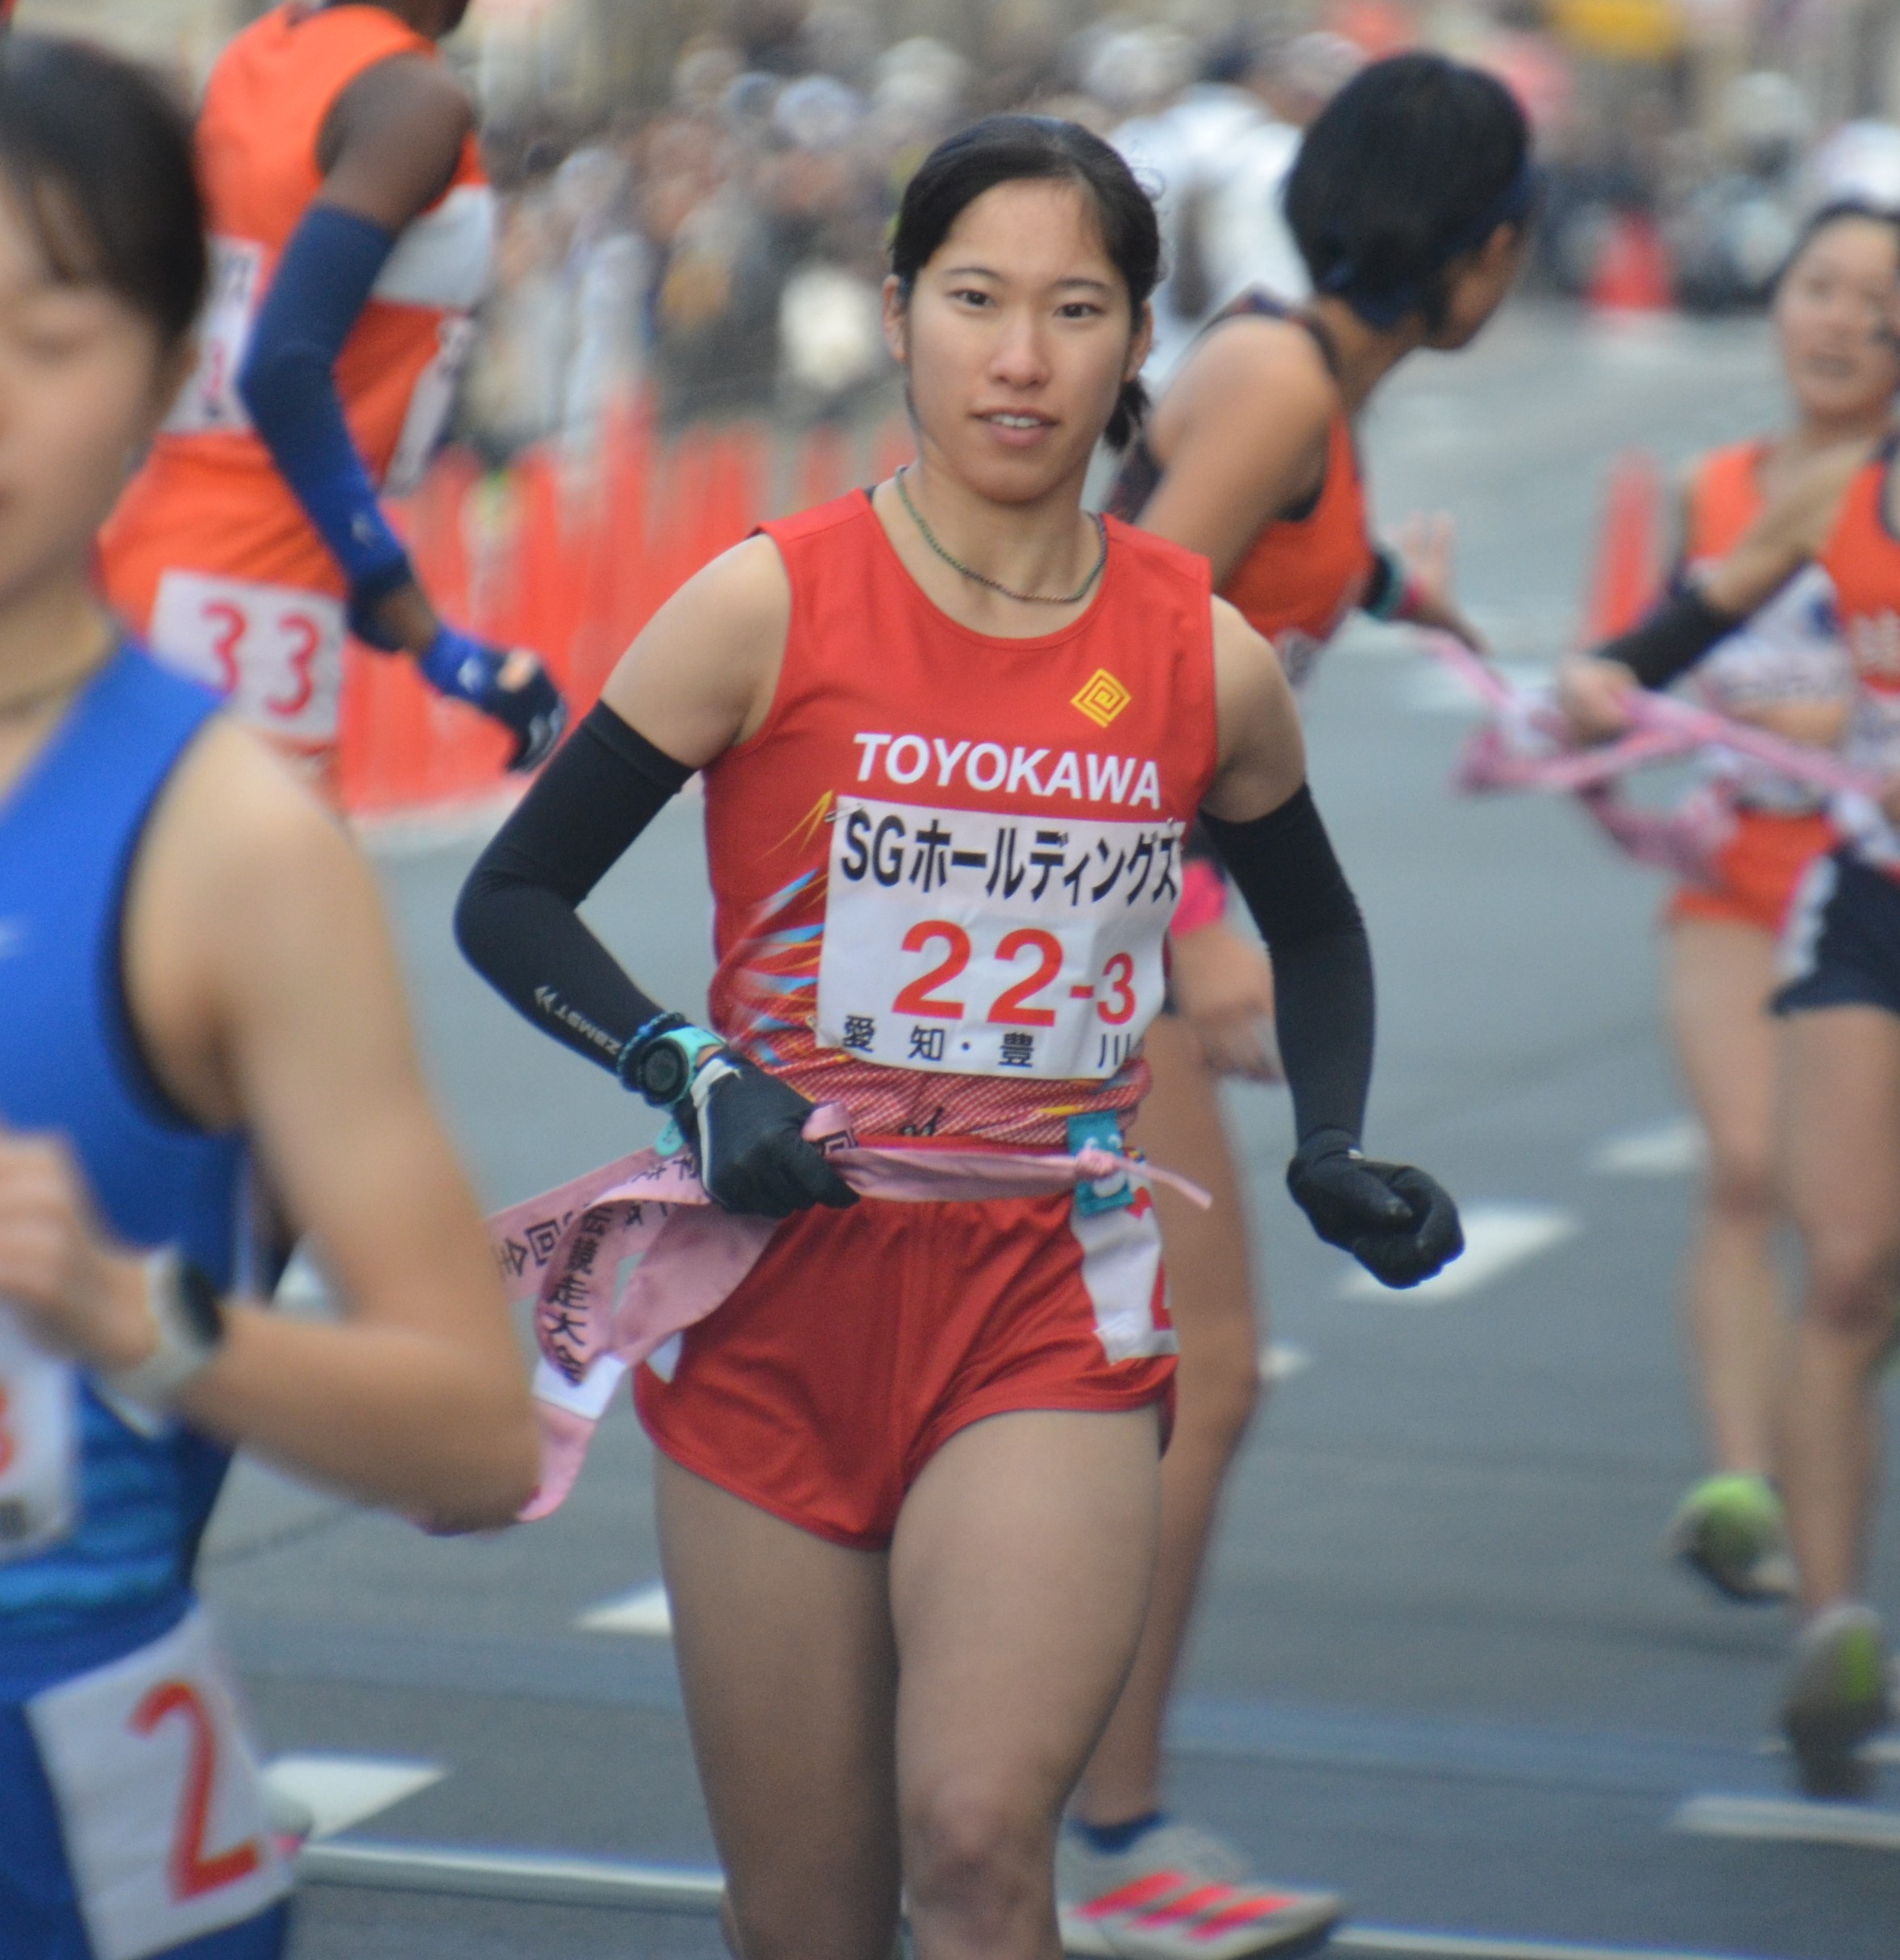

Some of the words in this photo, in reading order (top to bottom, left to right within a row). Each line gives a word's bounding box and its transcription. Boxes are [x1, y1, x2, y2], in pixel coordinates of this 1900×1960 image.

[853, 732, 1161, 810] TOYOKAWA
[841, 809, 1179, 907] SGホールディングス
[891, 919, 1137, 1027] 22-3
[129, 1679, 262, 1905] 2
